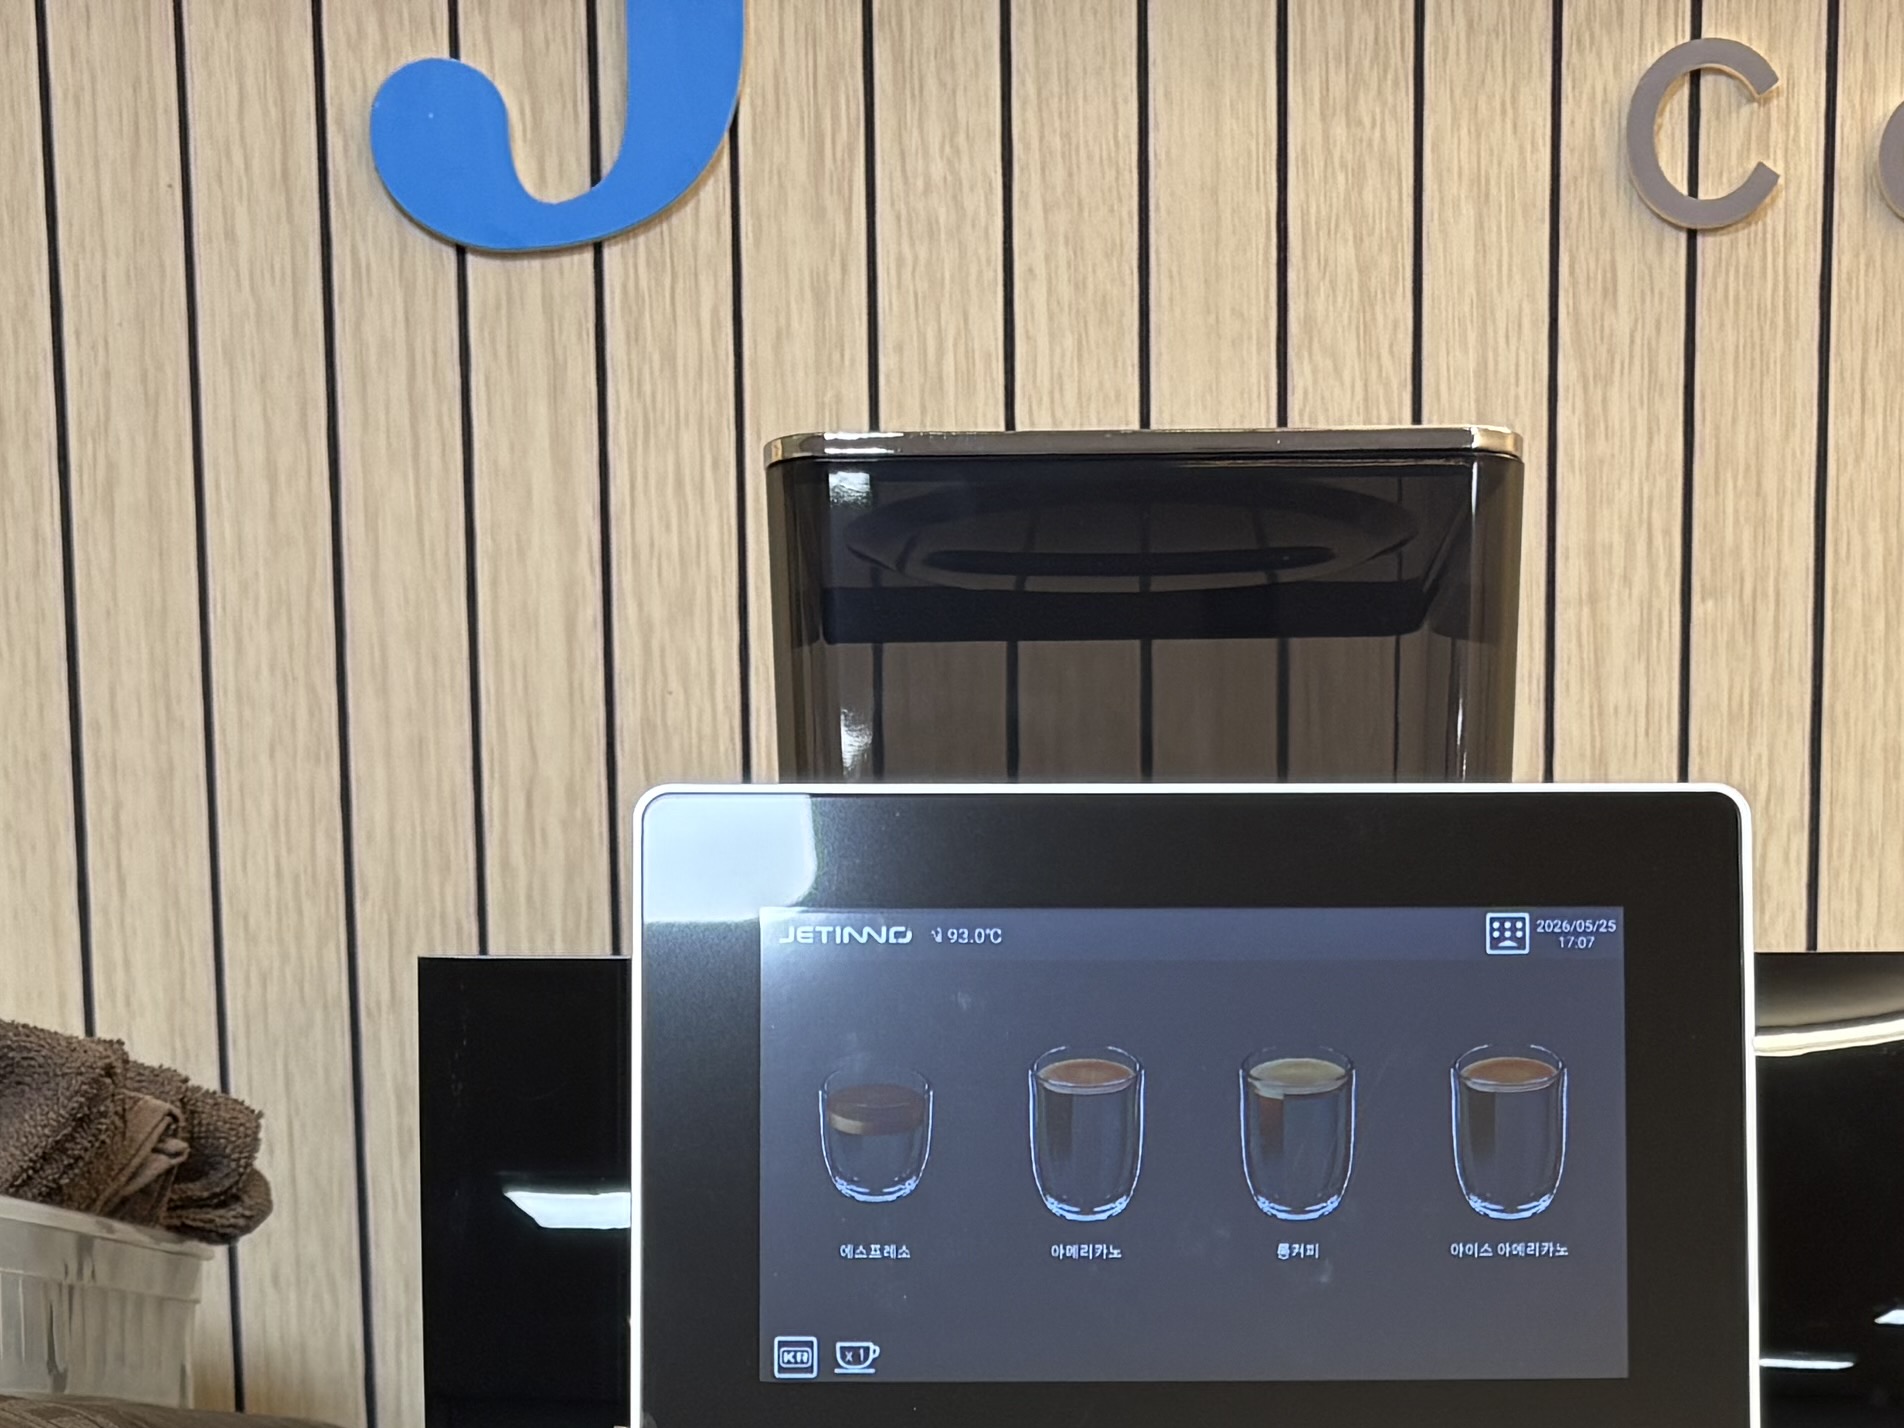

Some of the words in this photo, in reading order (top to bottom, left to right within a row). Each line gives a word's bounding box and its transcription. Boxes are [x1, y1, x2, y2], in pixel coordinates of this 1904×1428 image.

[1536, 920, 1616, 932] 2026/05/25
[779, 926, 912, 944] JETINNO
[1559, 936, 1595, 949] 17:07
[839, 1243, 911, 1259] 에스프레소
[1050, 1243, 1122, 1260] 아메리카노
[1450, 1242, 1493, 1258] 아이스
[1497, 1242, 1569, 1258] 아메리카노
